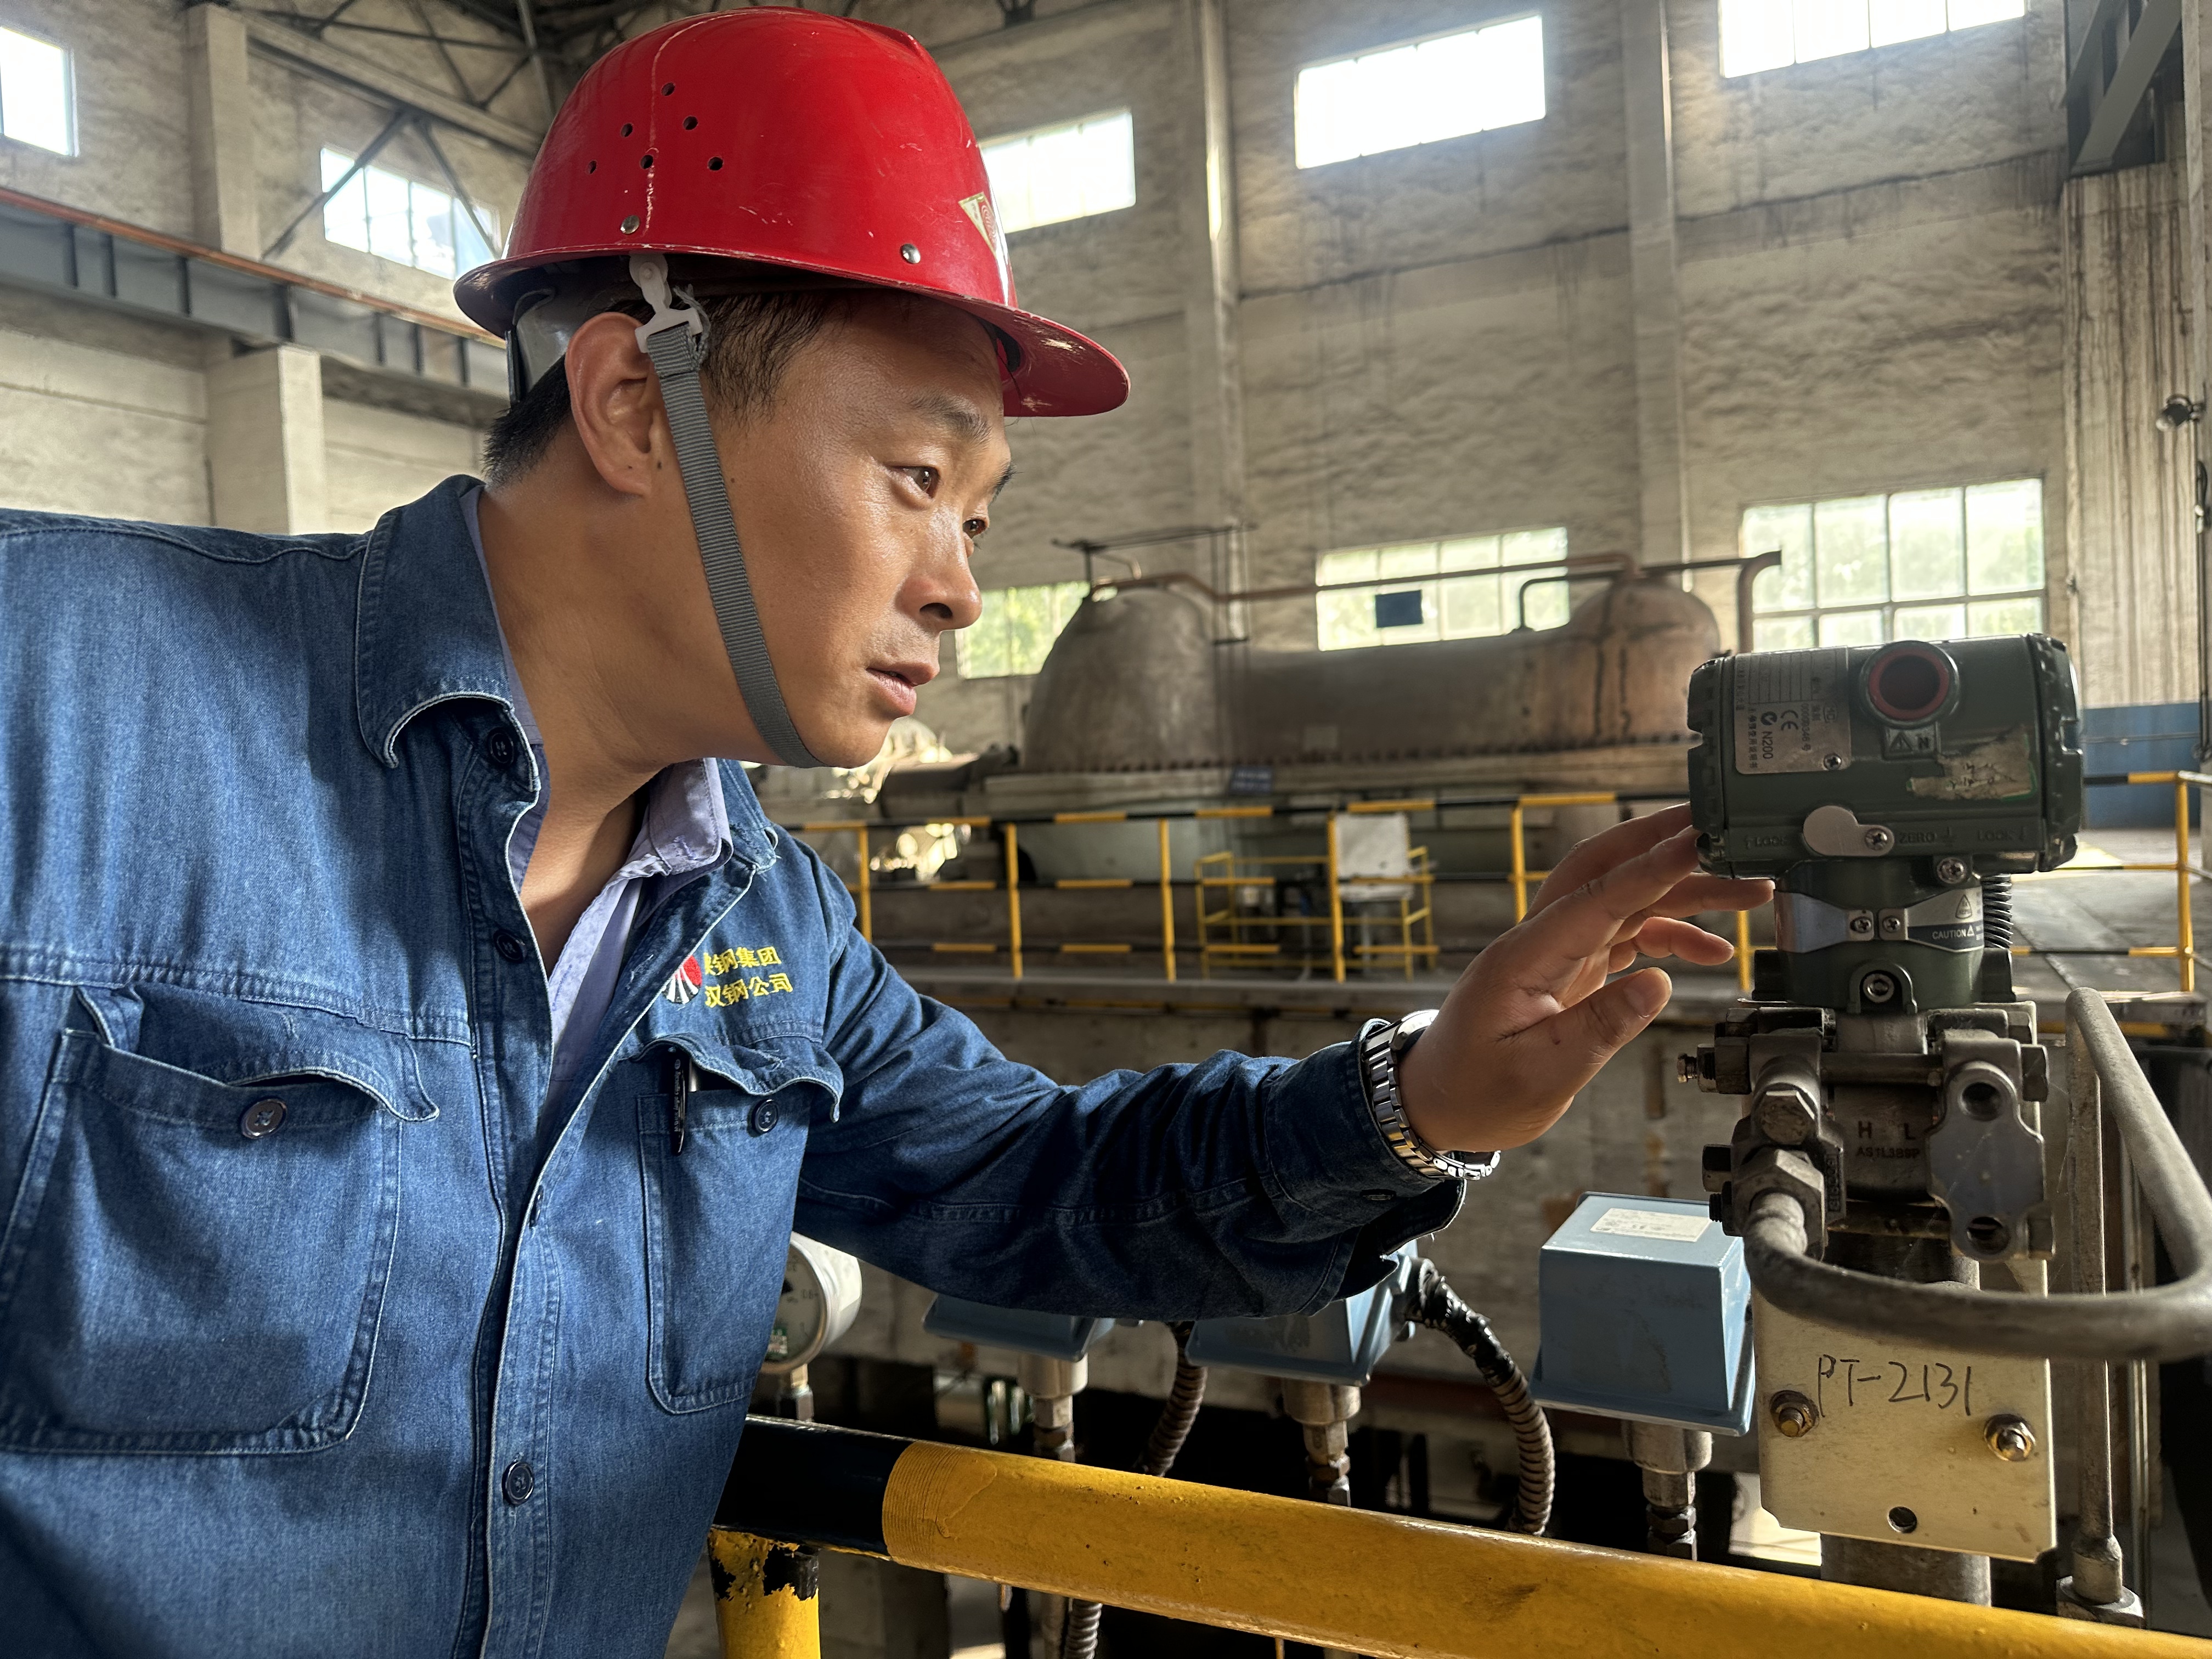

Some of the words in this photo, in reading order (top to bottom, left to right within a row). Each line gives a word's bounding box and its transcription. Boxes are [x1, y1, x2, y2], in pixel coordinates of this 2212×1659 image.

[1761, 731, 1774, 759] N200
[1899, 831, 1936, 844] ZERO
[1932, 928, 1967, 940] CAUTION
[704, 973, 793, 1008] 汉钢公司
[1858, 1120, 1872, 1138] H
[1903, 1122, 1916, 1140] L
[1817, 1354, 1973, 1418] PT-2131
